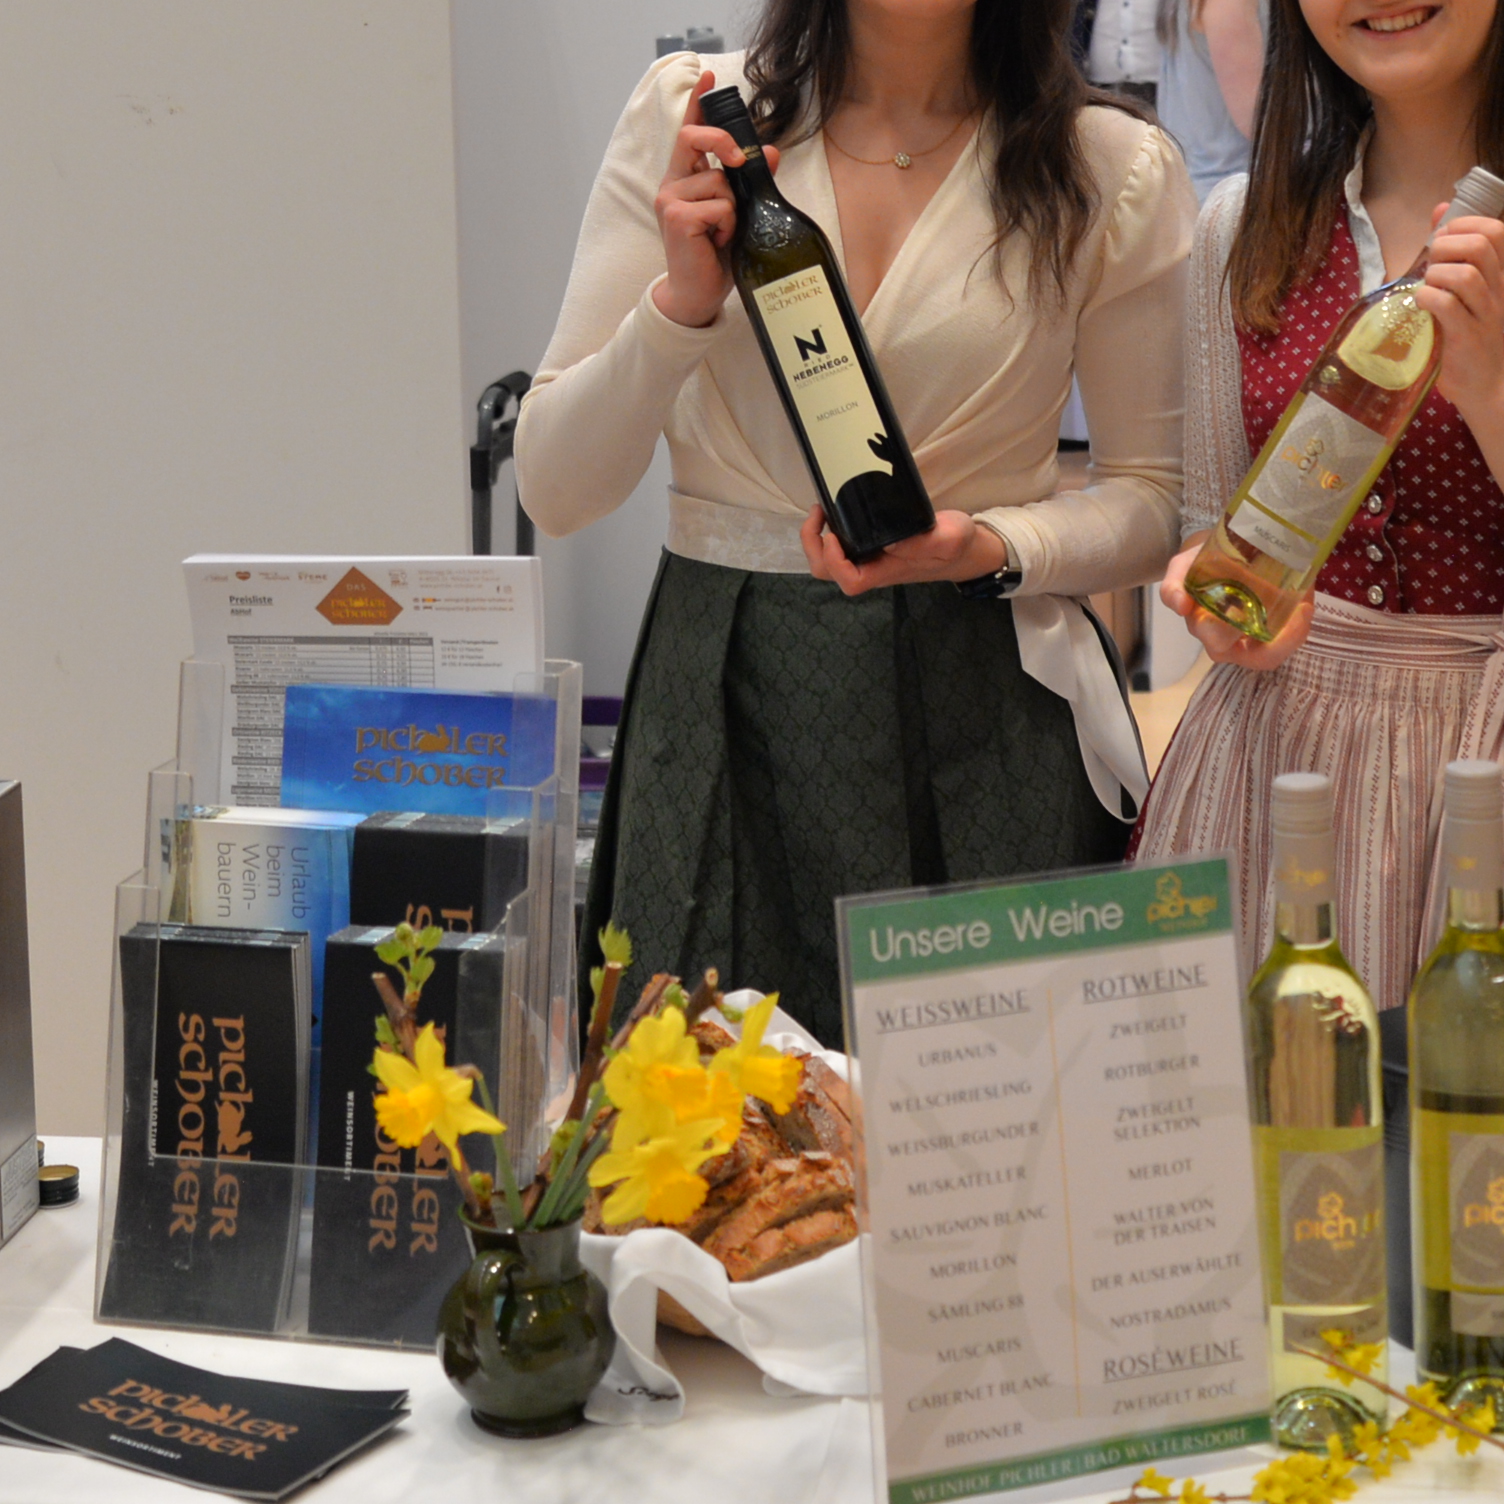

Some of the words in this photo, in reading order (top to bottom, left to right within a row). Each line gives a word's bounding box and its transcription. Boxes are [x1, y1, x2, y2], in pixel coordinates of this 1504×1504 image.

[793, 327, 828, 362] N
[793, 355, 849, 383] NEBENEGG
[816, 401, 859, 423] MORILLON
[229, 595, 274, 606] Preisliste
[217, 842, 237, 919] bauern
[242, 842, 261, 911] Wein-
[266, 844, 285, 898] beim
[291, 845, 309, 921] Urlaub
[869, 918, 992, 963] Unsere
[1008, 900, 1125, 943] Weine
[1082, 964, 1209, 1001] ROTWEINE
[876, 989, 1031, 1030] WEISSWEINE
[1109, 1014, 1189, 1040] ZWEIGELT
[918, 1042, 998, 1068] URBANUS
[1103, 1054, 1201, 1083] ROTBURGER
[889, 1079, 1033, 1115] WELSCHRIESLING
[1116, 1097, 1195, 1123] ZWEIGELT
[887, 1121, 1041, 1158] WEISSBURGUNDER
[1113, 1115, 1202, 1143] SELEKTION
[907, 1165, 1027, 1198] MUSKATELLER
[1128, 1158, 1193, 1183] MERLOT
[889, 1215, 990, 1244] SAUVIGNON
[993, 1205, 1050, 1228] BLANC
[1113, 1200, 1178, 1226] WALTER
[1179, 1197, 1215, 1218] VON
[1113, 1225, 1145, 1247] DER
[1147, 1216, 1217, 1242] TRAISEN
[929, 1252, 1018, 1281] MORILLON
[1091, 1271, 1125, 1293] DER
[1127, 1252, 1243, 1289] AUSERWÄHLTE
[927, 1297, 999, 1325] SÄMLING
[1006, 1295, 1025, 1311] 88
[1110, 1297, 1233, 1330] NOSTRADAMUS
[937, 1336, 1022, 1365] MUSCARIS
[1102, 1338, 1244, 1381] ROSÉWEINE
[906, 1384, 997, 1414] CABERNET
[999, 1373, 1054, 1397] BLANC
[1112, 1389, 1193, 1415] ZWEIGELT
[108, 1433, 183, 1461] WEINSORTIMENT
[944, 1422, 1024, 1449] BRONNER
[910, 1473, 993, 1504] WEINHOF
[999, 1457, 1074, 1485] PICHLER
[1084, 1447, 1121, 1470] BAD
[1126, 1428, 1249, 1461] WALTERSDORF
